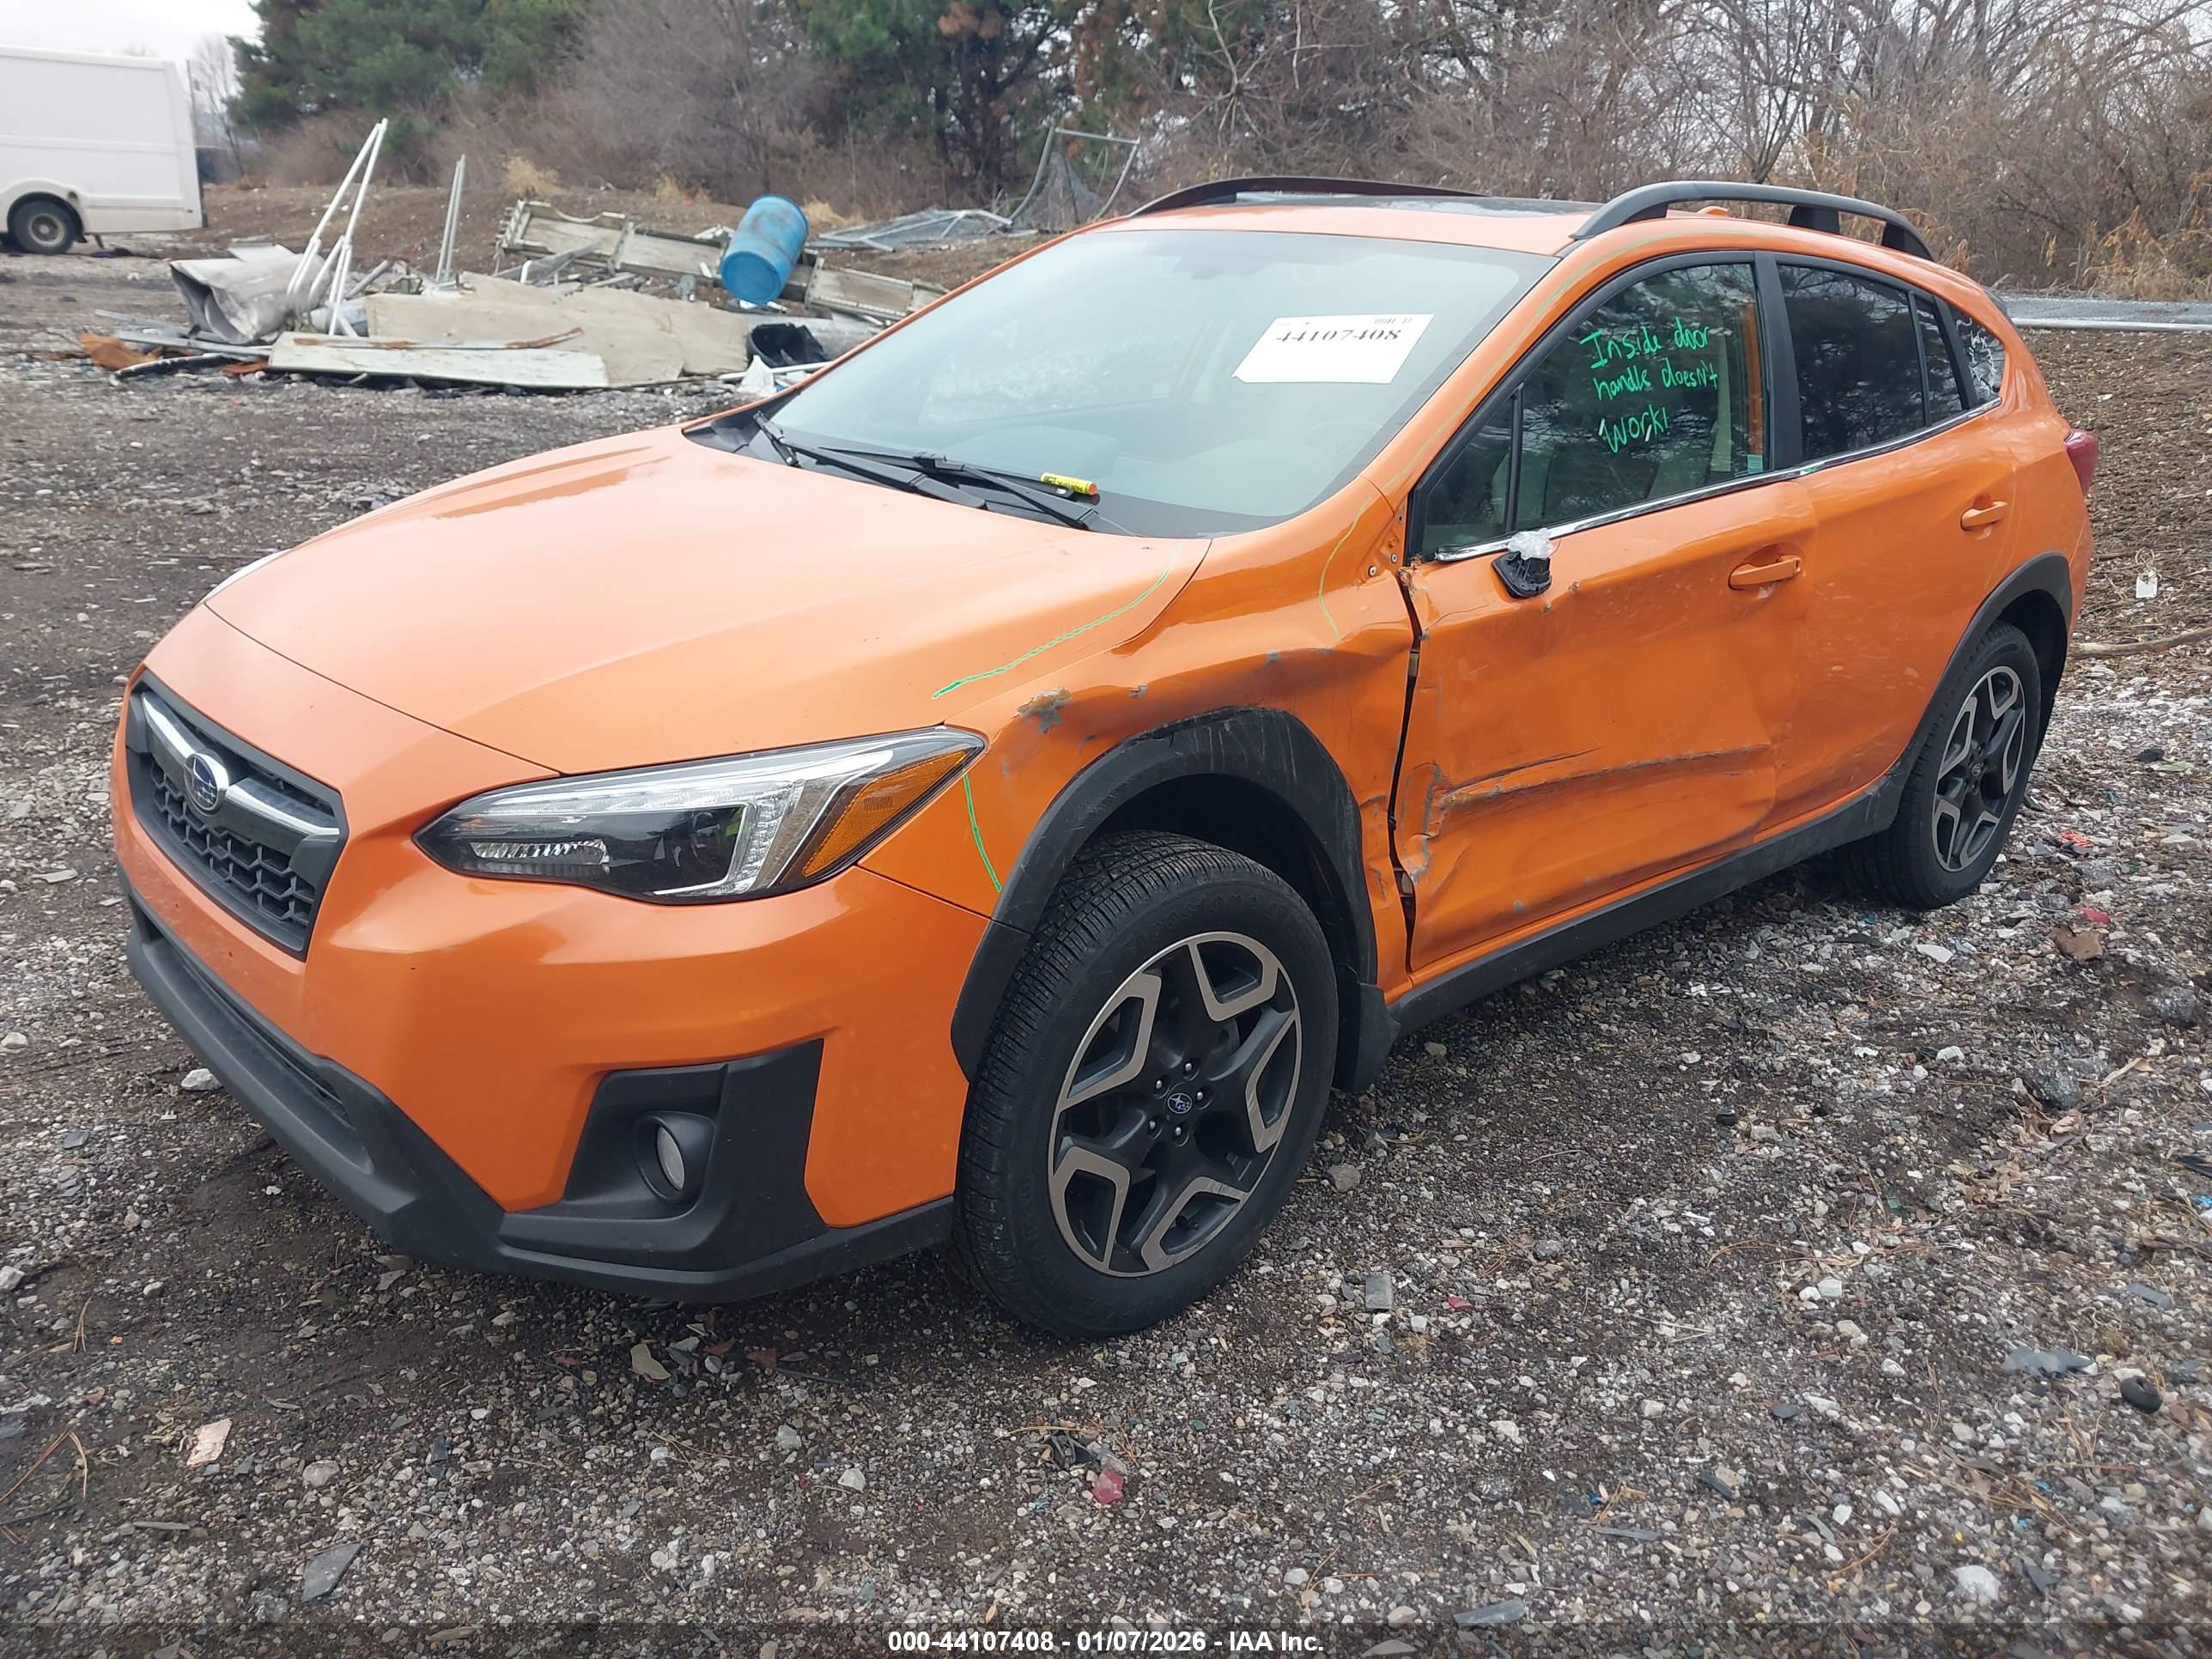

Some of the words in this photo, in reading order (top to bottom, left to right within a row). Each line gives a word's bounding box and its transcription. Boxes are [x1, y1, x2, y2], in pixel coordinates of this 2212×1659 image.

[1276, 329, 1401, 342] 44107408
[1580, 326, 1662, 369] Inside
[1674, 316, 1710, 349] door
[1594, 365, 1651, 400] handle
